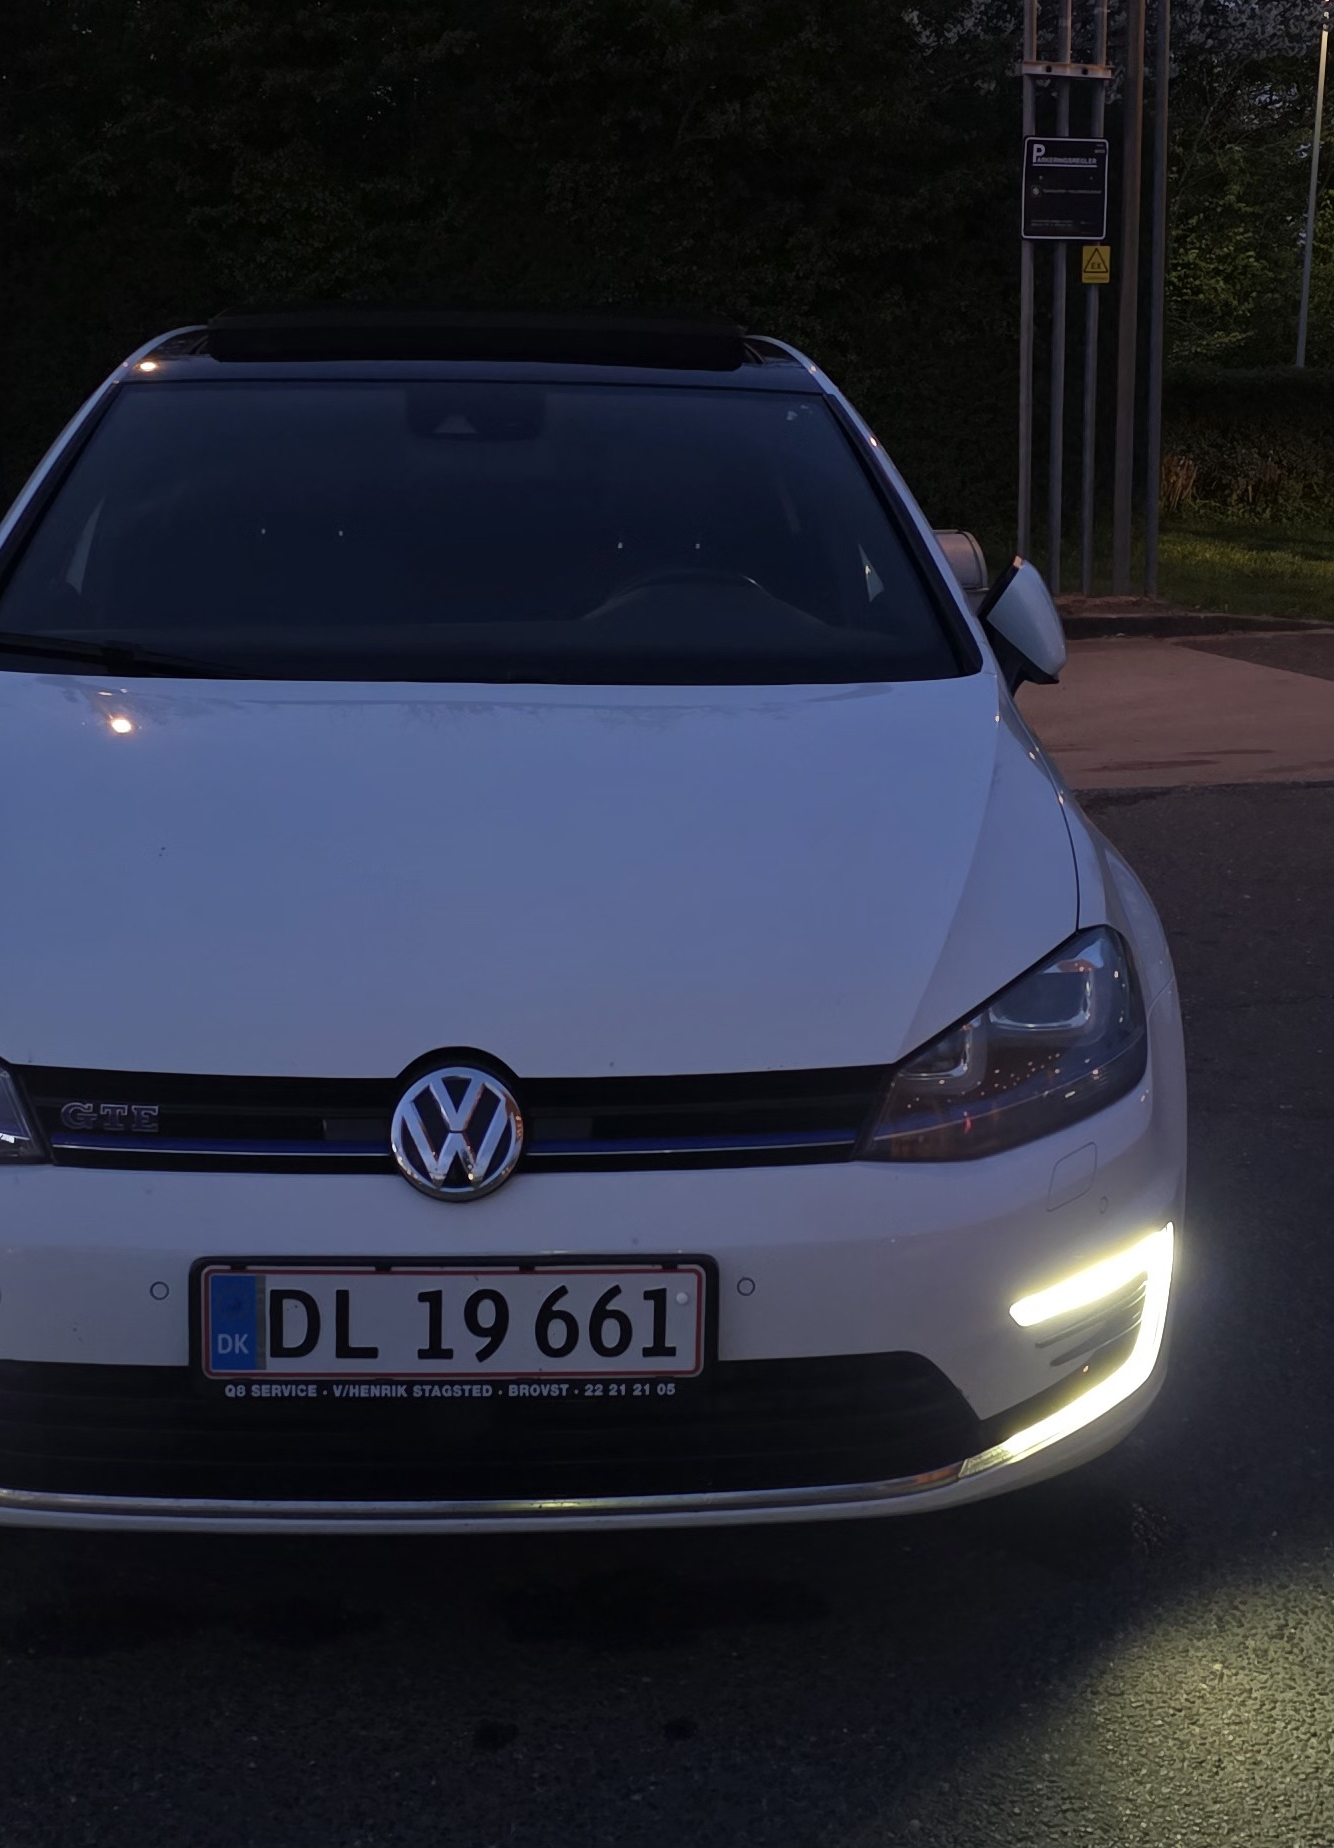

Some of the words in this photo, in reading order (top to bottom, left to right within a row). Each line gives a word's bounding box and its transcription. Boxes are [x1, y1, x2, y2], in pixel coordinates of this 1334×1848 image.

[1090, 262, 1102, 270] EX
[61, 1102, 160, 1133] GTE
[269, 1288, 379, 1359] DL
[417, 1288, 509, 1363] 19
[534, 1284, 677, 1358] 661
[217, 1333, 250, 1355] DK
[224, 1384, 246, 1398] Q8
[251, 1384, 317, 1398] SERVICE
[332, 1384, 408, 1398] V/HENRIK
[412, 1384, 493, 1398] STAGSTED
[508, 1384, 569, 1397] BROVST
[584, 1384, 604, 1396] 22
[608, 1384, 626, 1396] 21
[632, 1383, 650, 1396] 21
[656, 1383, 676, 1396] 05
